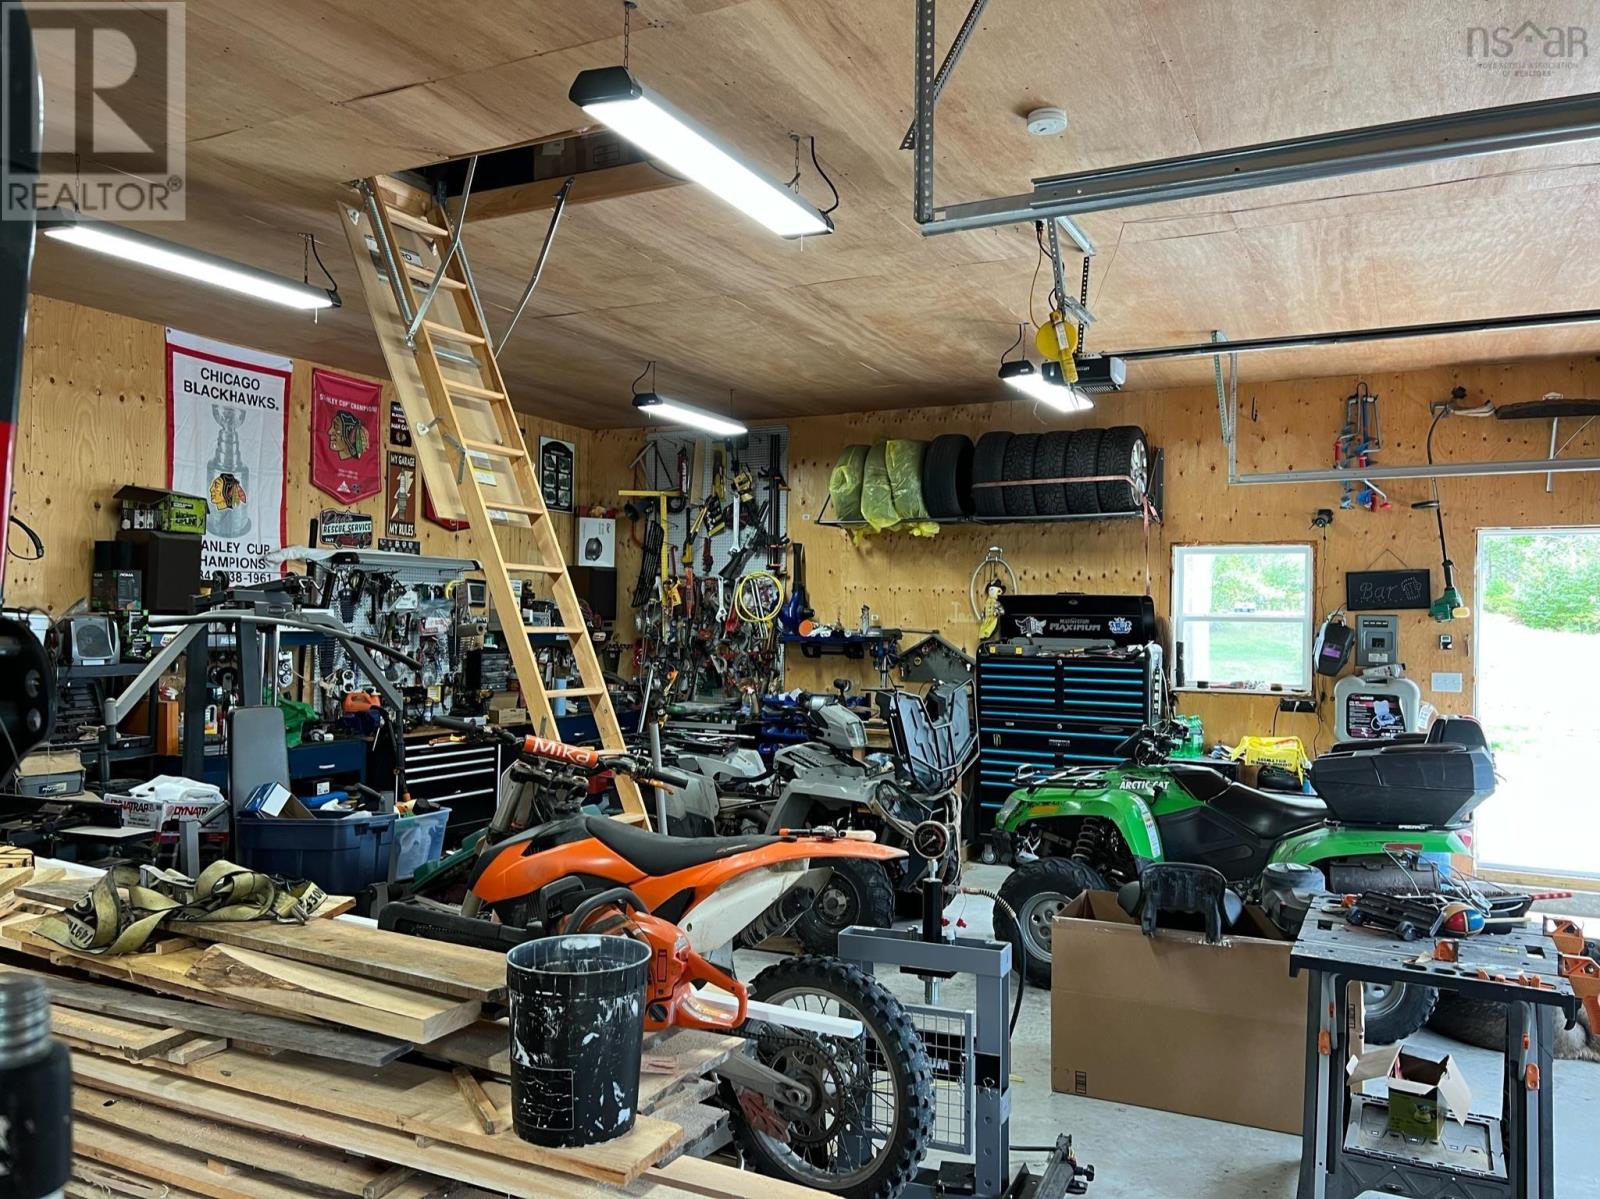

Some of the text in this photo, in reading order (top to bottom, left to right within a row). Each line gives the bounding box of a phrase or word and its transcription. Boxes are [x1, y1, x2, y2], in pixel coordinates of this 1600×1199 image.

[200, 367, 260, 390] CHICAGO
[183, 380, 279, 411] BLACKHAWKS.
[391, 454, 398, 464] MY
[323, 522, 371, 534] RESCUE SERVICE
[389, 523, 414, 537] MY RULES
[201, 540, 270, 555] ANLEY CUP
[201, 555, 266, 570] HAMPIONS
[1360, 582, 1399, 600] Bar
[1120, 780, 1170, 790] ARCTIC CAT
[174, 806, 212, 817] DYNATR
